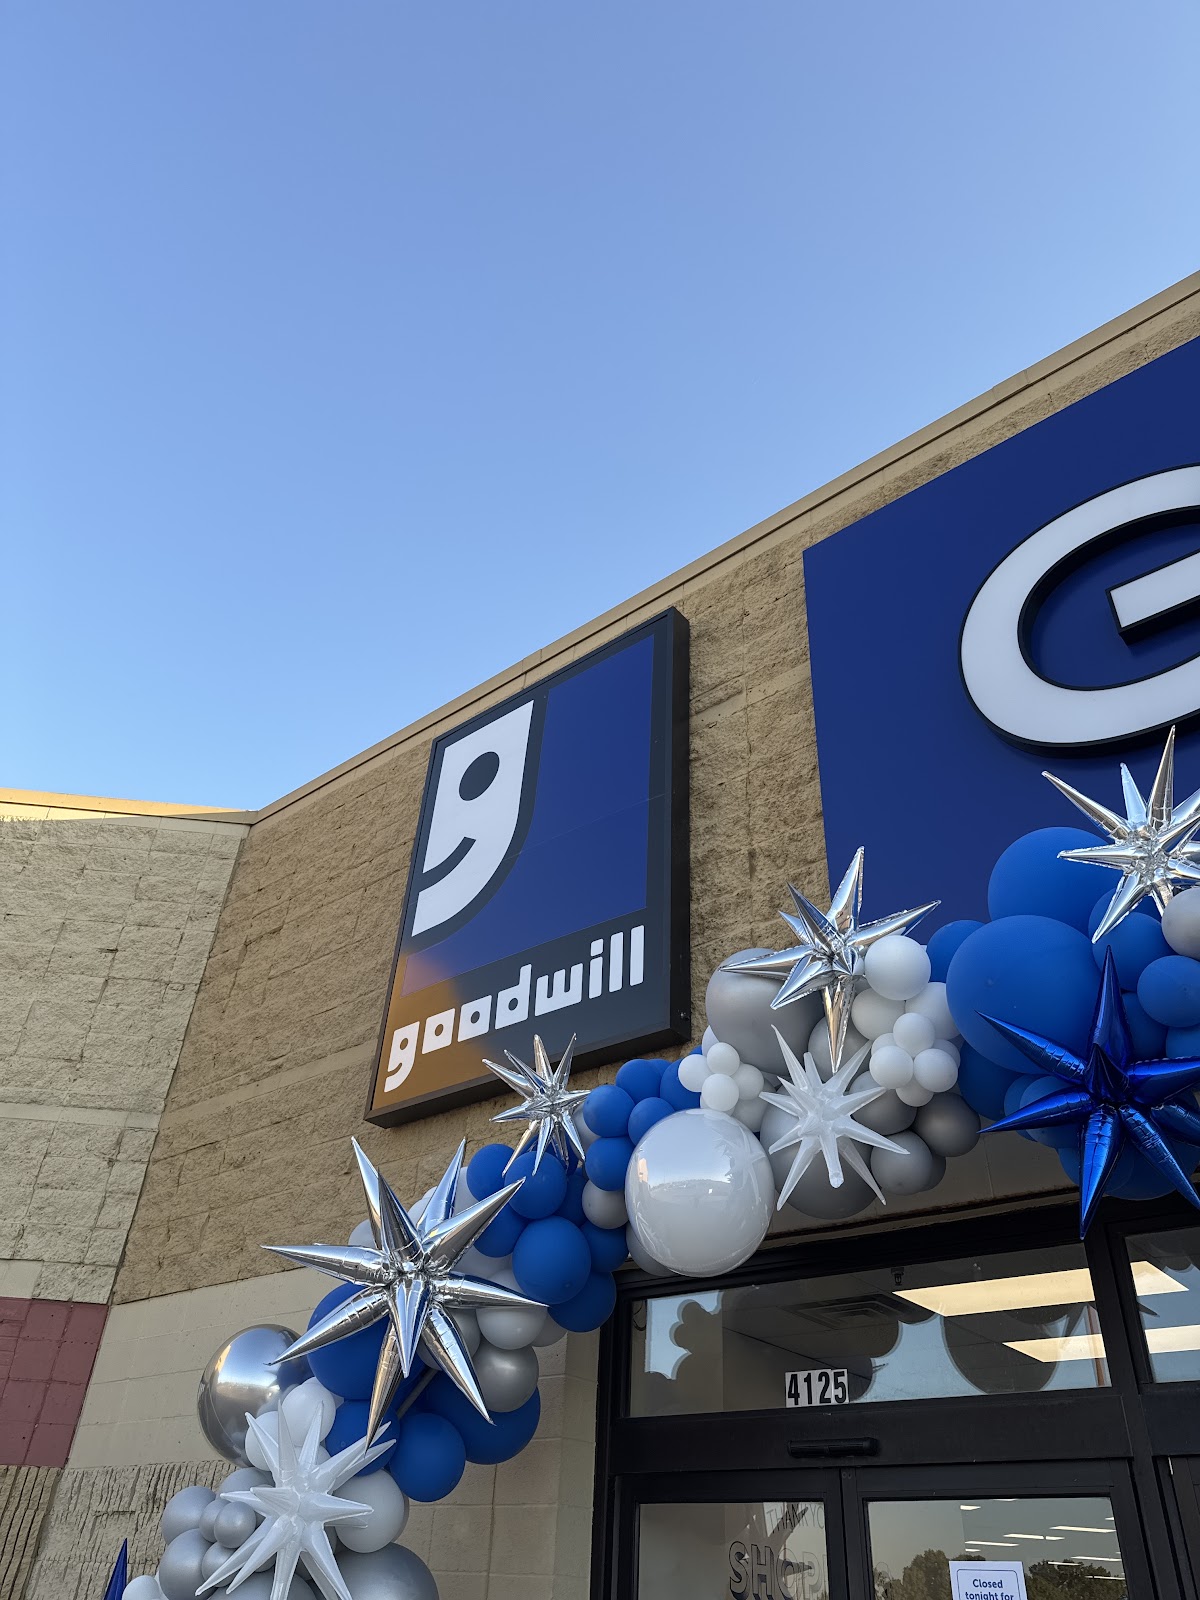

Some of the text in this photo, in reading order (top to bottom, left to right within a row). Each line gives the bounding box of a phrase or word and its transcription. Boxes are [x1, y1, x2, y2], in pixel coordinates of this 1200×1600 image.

[383, 924, 645, 1094] goodwill
[787, 1370, 847, 1406] 4125
[766, 1503, 809, 1534] THANK
[728, 1541, 828, 1600] SHOP
[972, 1578, 1003, 1588] Closed
[965, 1591, 1014, 1600] tonight for
